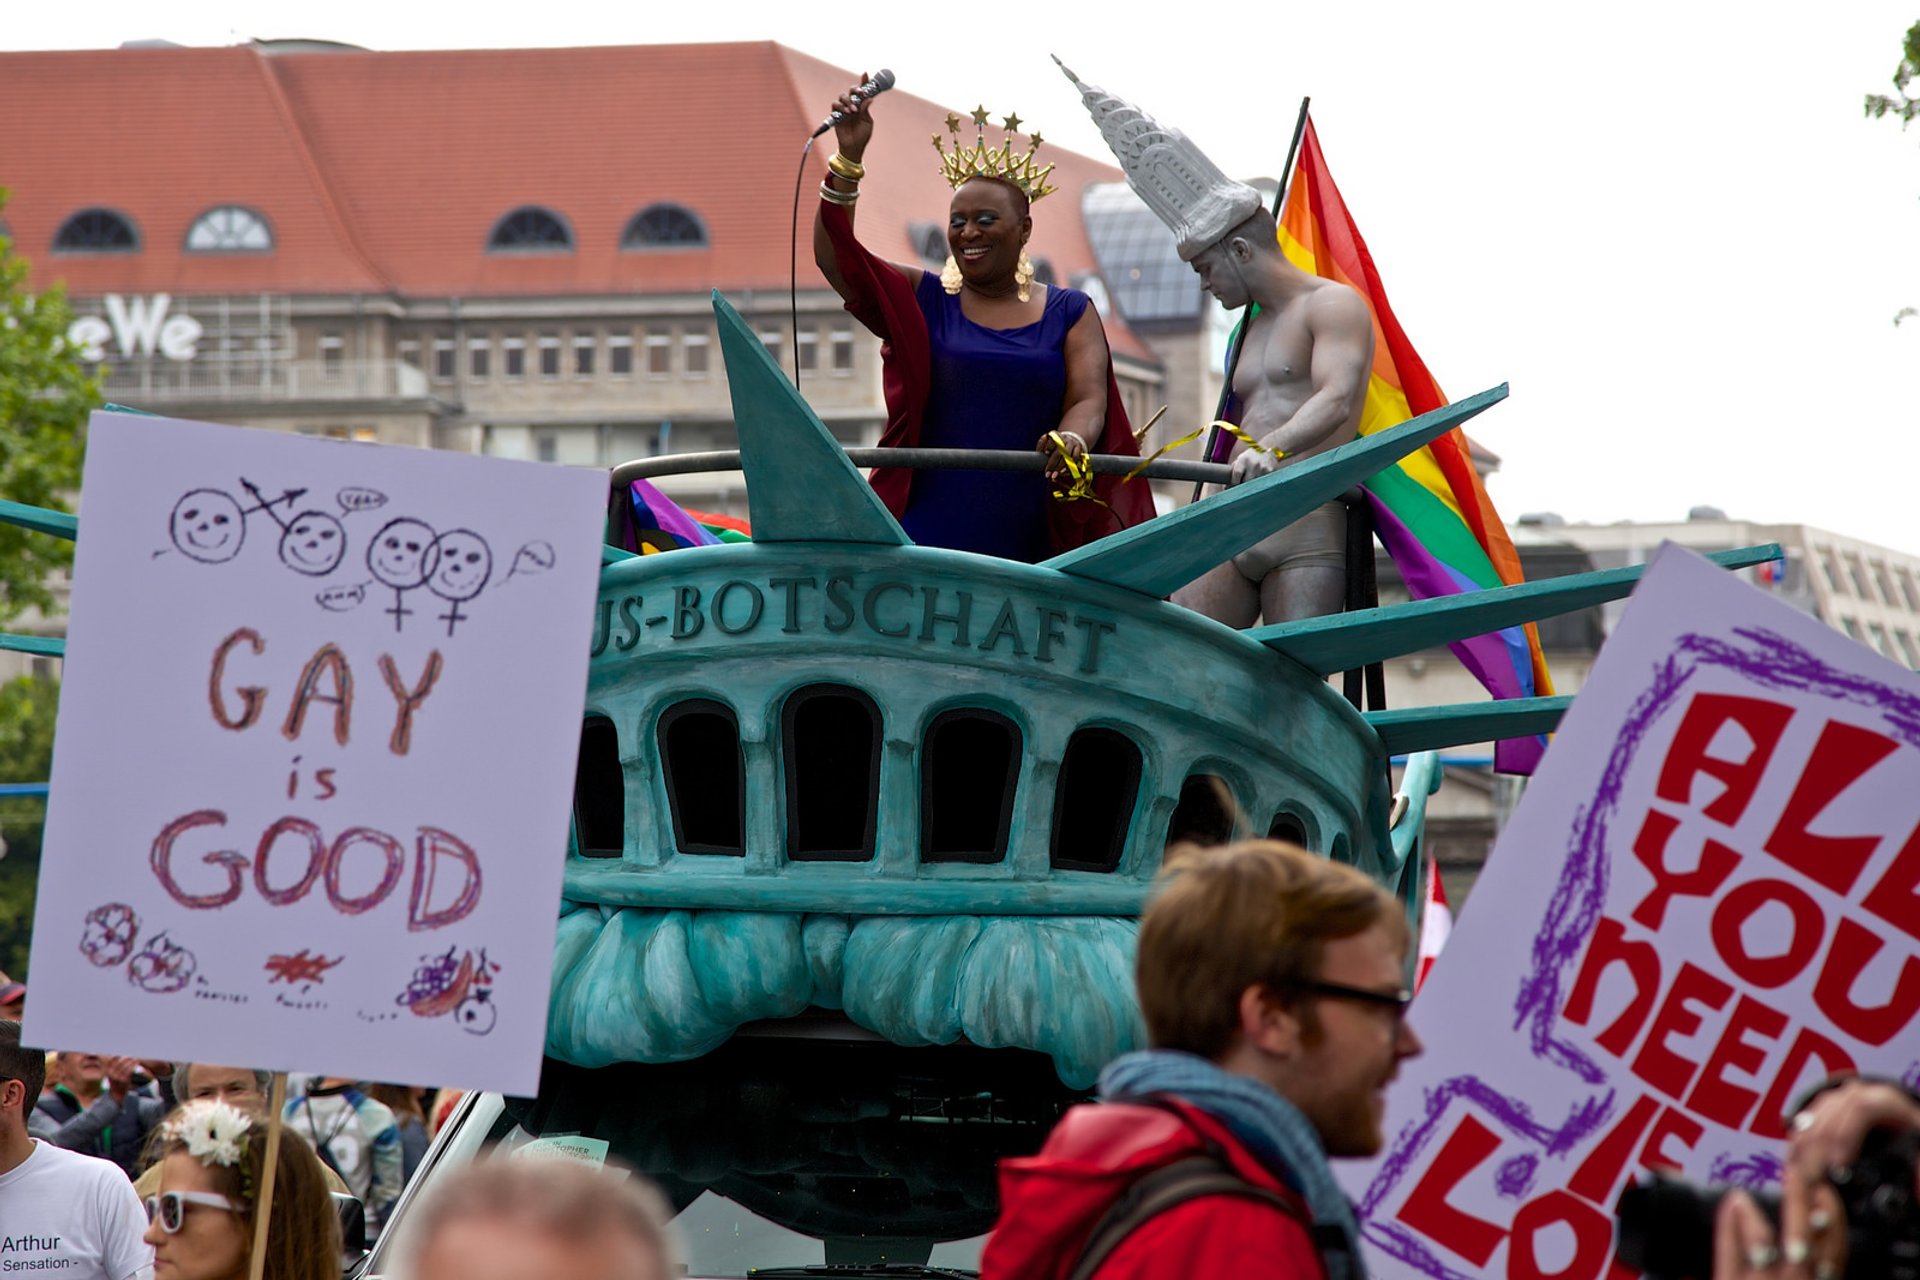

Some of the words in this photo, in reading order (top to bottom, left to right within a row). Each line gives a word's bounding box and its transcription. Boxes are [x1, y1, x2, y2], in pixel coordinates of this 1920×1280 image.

[209, 627, 443, 755] GAY
[287, 756, 337, 799] is
[150, 810, 482, 932] GOOD
[1630, 807, 1920, 1048] YOU
[1, 1234, 61, 1254] Arthur
[3, 1257, 69, 1272] Sensation
